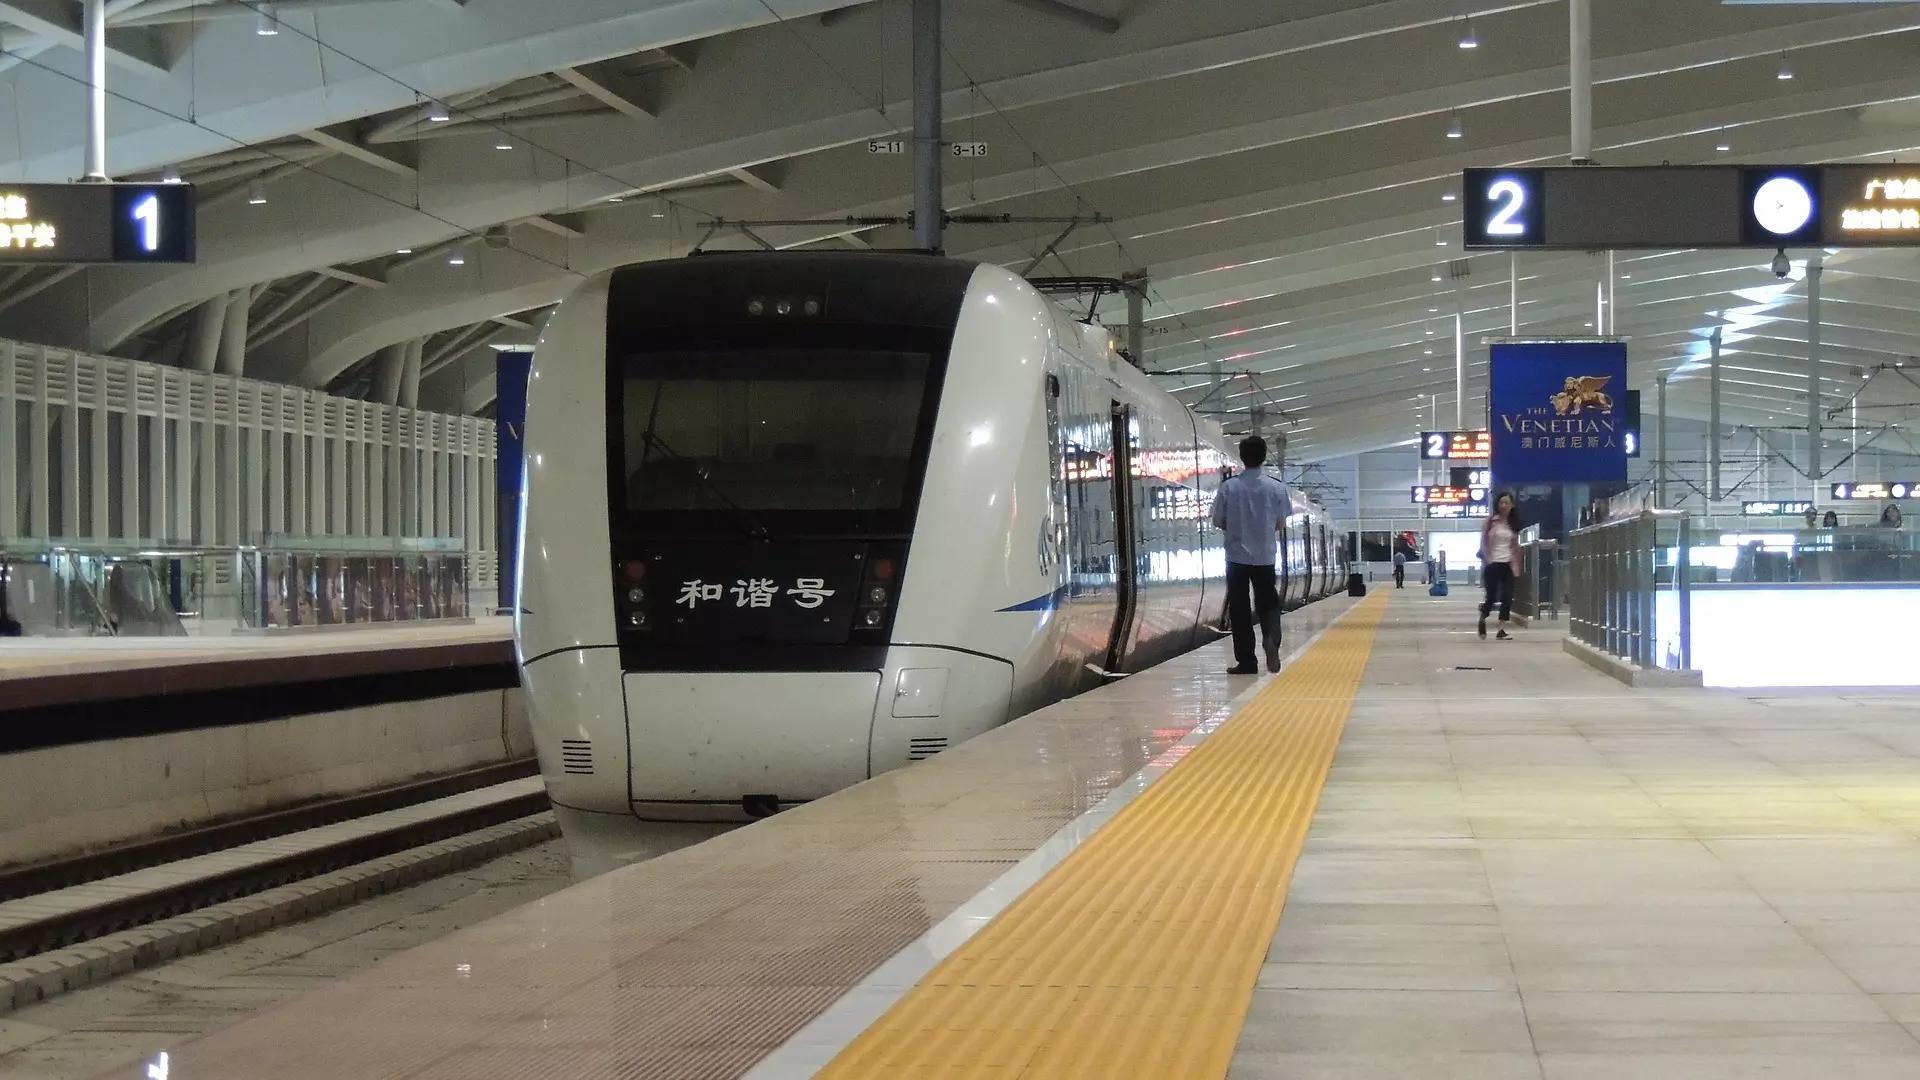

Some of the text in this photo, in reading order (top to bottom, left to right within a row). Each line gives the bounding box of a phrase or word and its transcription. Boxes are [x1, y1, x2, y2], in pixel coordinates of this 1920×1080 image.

[870, 142, 900, 152] 5-11
[953, 145, 986, 156] 3-13
[1486, 180, 1524, 235] 2
[134, 195, 158, 251] 1
[1526, 407, 1547, 415] THE
[1501, 414, 1615, 433] VENETIAN
[1428, 434, 1443, 456] 2
[1521, 436, 1616, 448] 澳门威尼斯人
[1415, 488, 1426, 501] 2
[1835, 484, 1846, 498] 4
[675, 577, 836, 609] 和谐号
